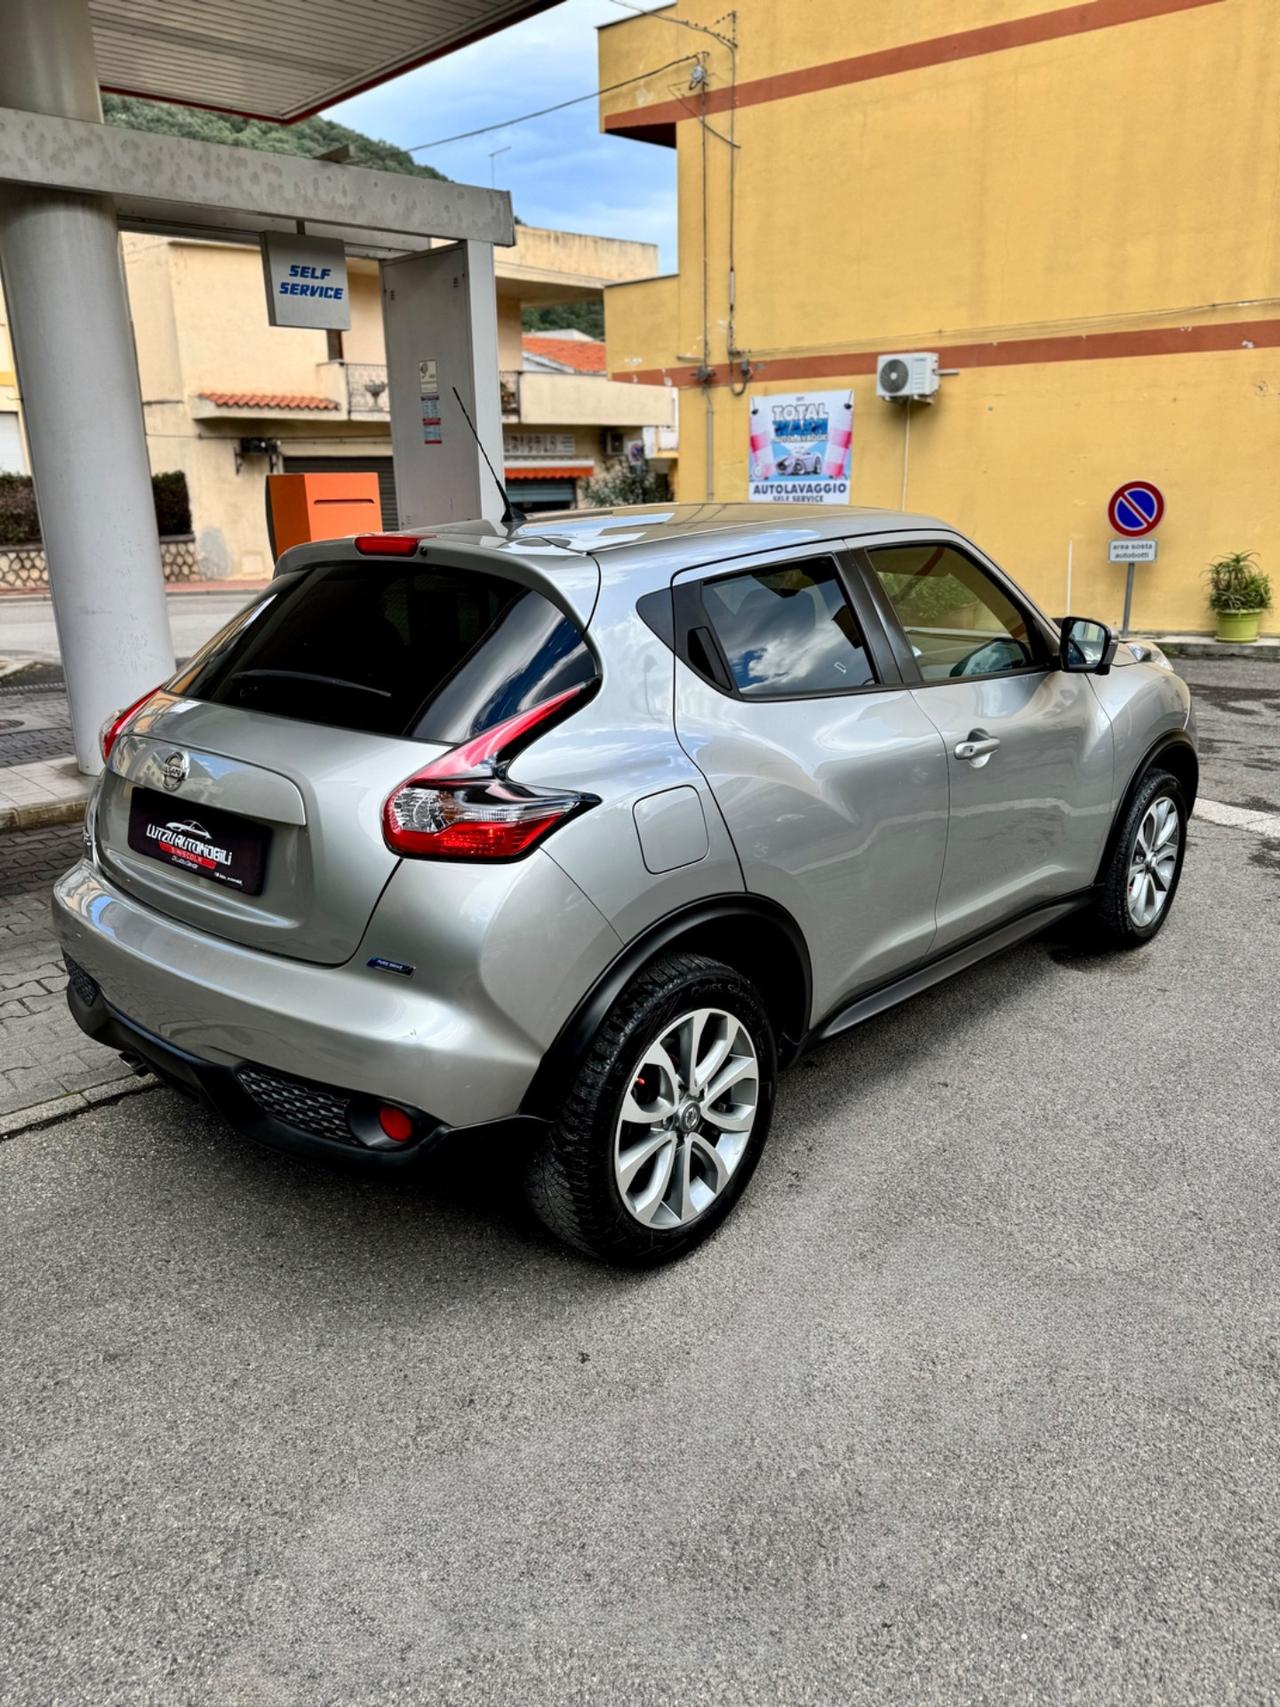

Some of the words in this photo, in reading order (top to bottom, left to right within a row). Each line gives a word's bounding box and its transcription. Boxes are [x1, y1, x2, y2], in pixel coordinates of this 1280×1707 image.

[288, 264, 332, 280] SELF
[279, 282, 344, 300] SERVICE
[772, 402, 829, 420] TOTAL
[753, 483, 847, 494] AUTOLAVAGGIO
[792, 495, 824, 503] SERVICE
[146, 823, 177, 846] LUTZU
